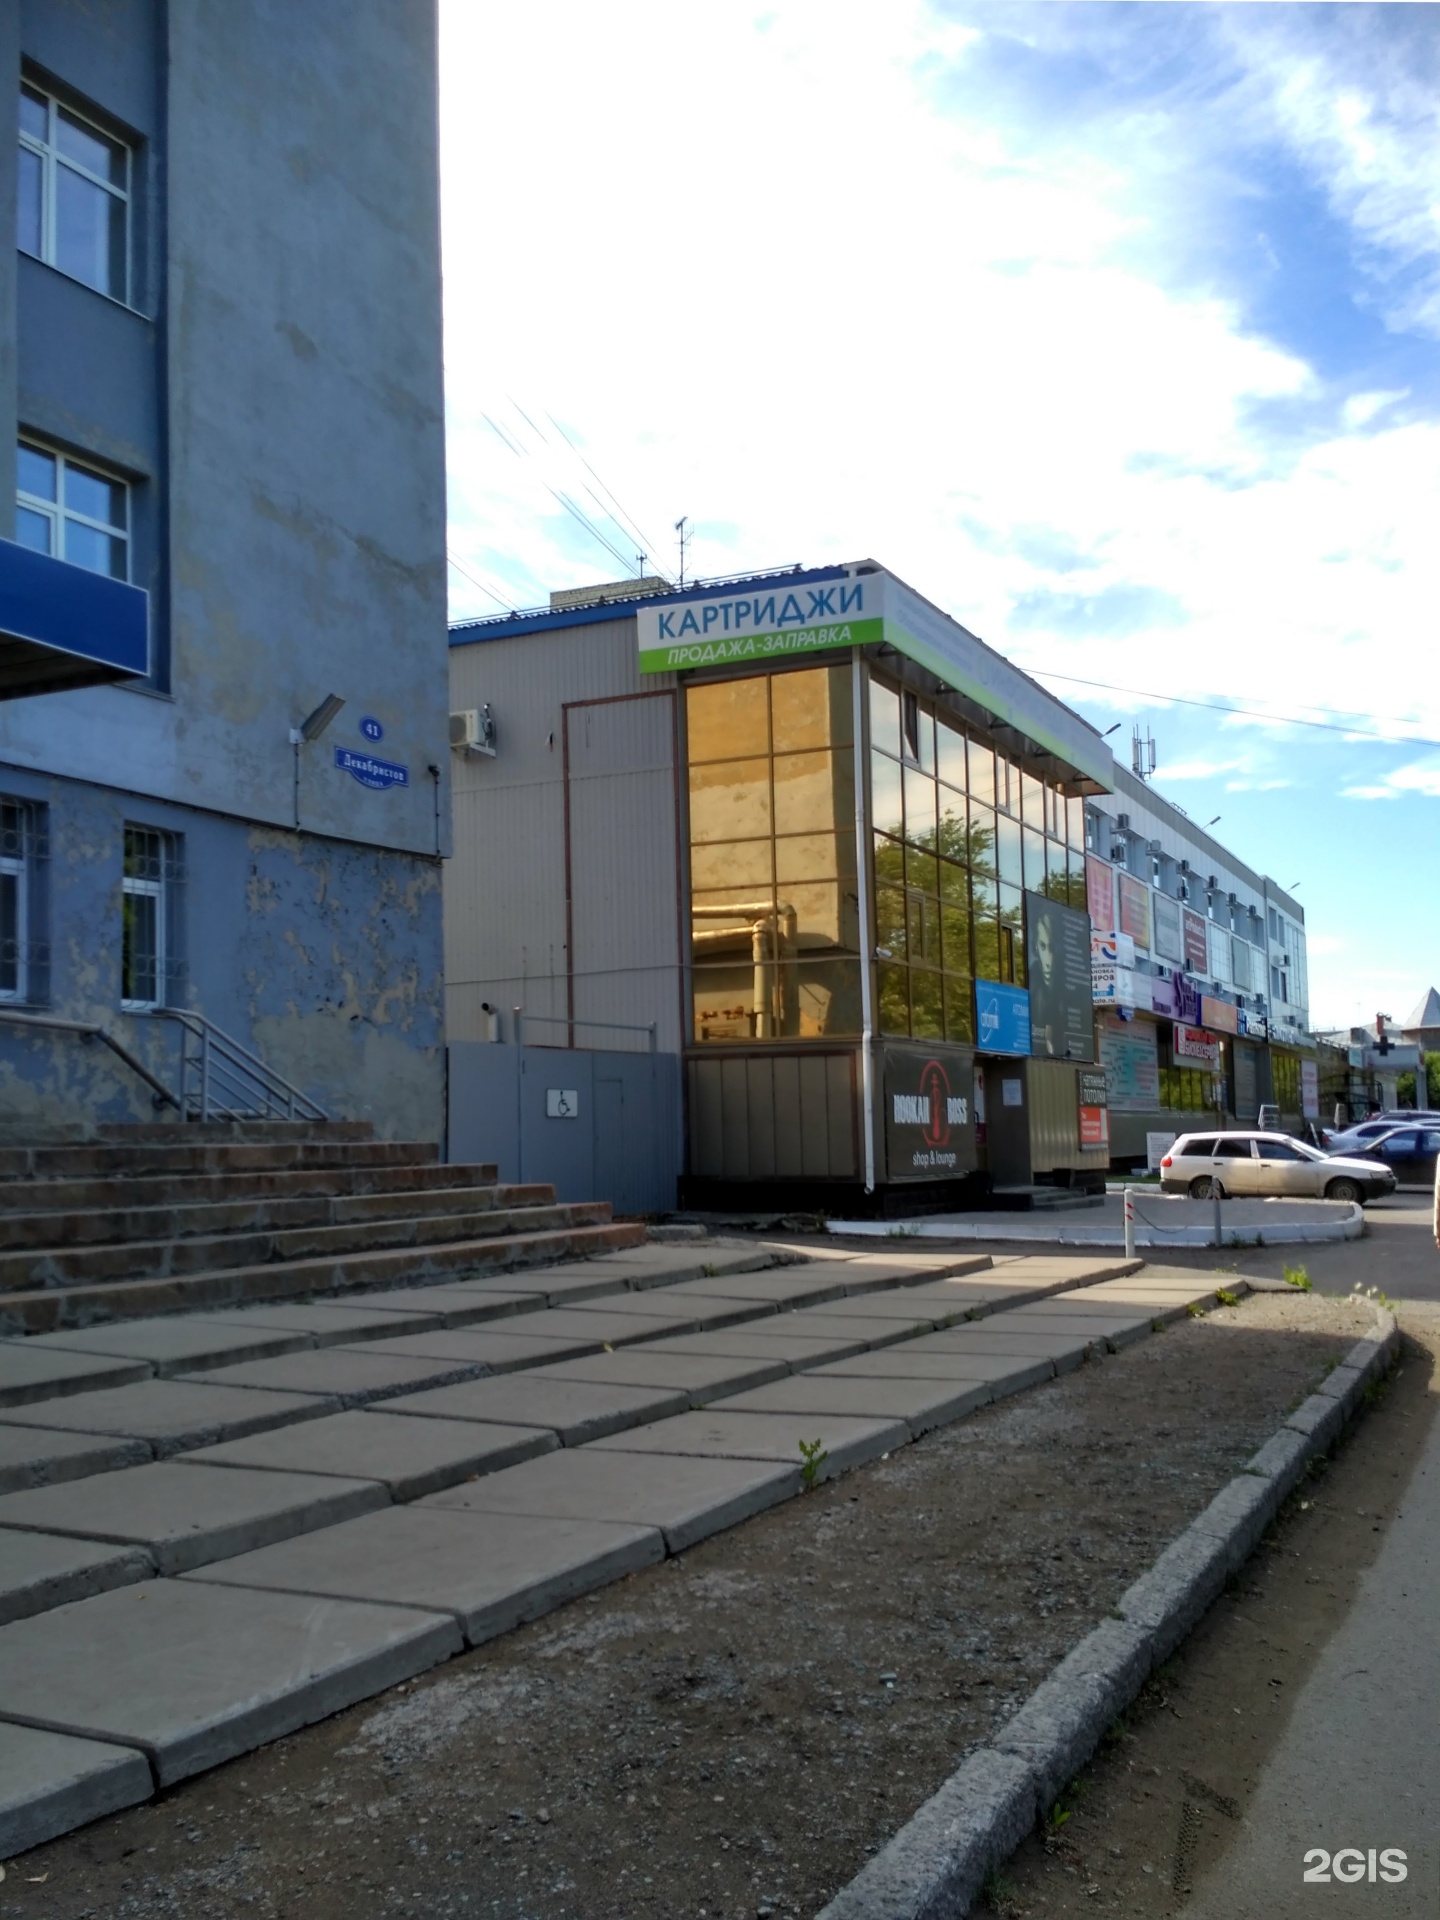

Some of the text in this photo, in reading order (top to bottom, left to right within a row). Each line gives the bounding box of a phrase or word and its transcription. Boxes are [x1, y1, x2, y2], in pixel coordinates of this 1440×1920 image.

[658, 583, 864, 639] КАРТРИДЖИ
[667, 625, 852, 665] ПРОДАЖА-ЗАПРАВКА
[366, 723, 379, 737] 41
[344, 754, 404, 781] Декабристов
[893, 1094, 968, 1124] HOOKAH BOSS
[912, 1150, 957, 1168] shop & lounge
